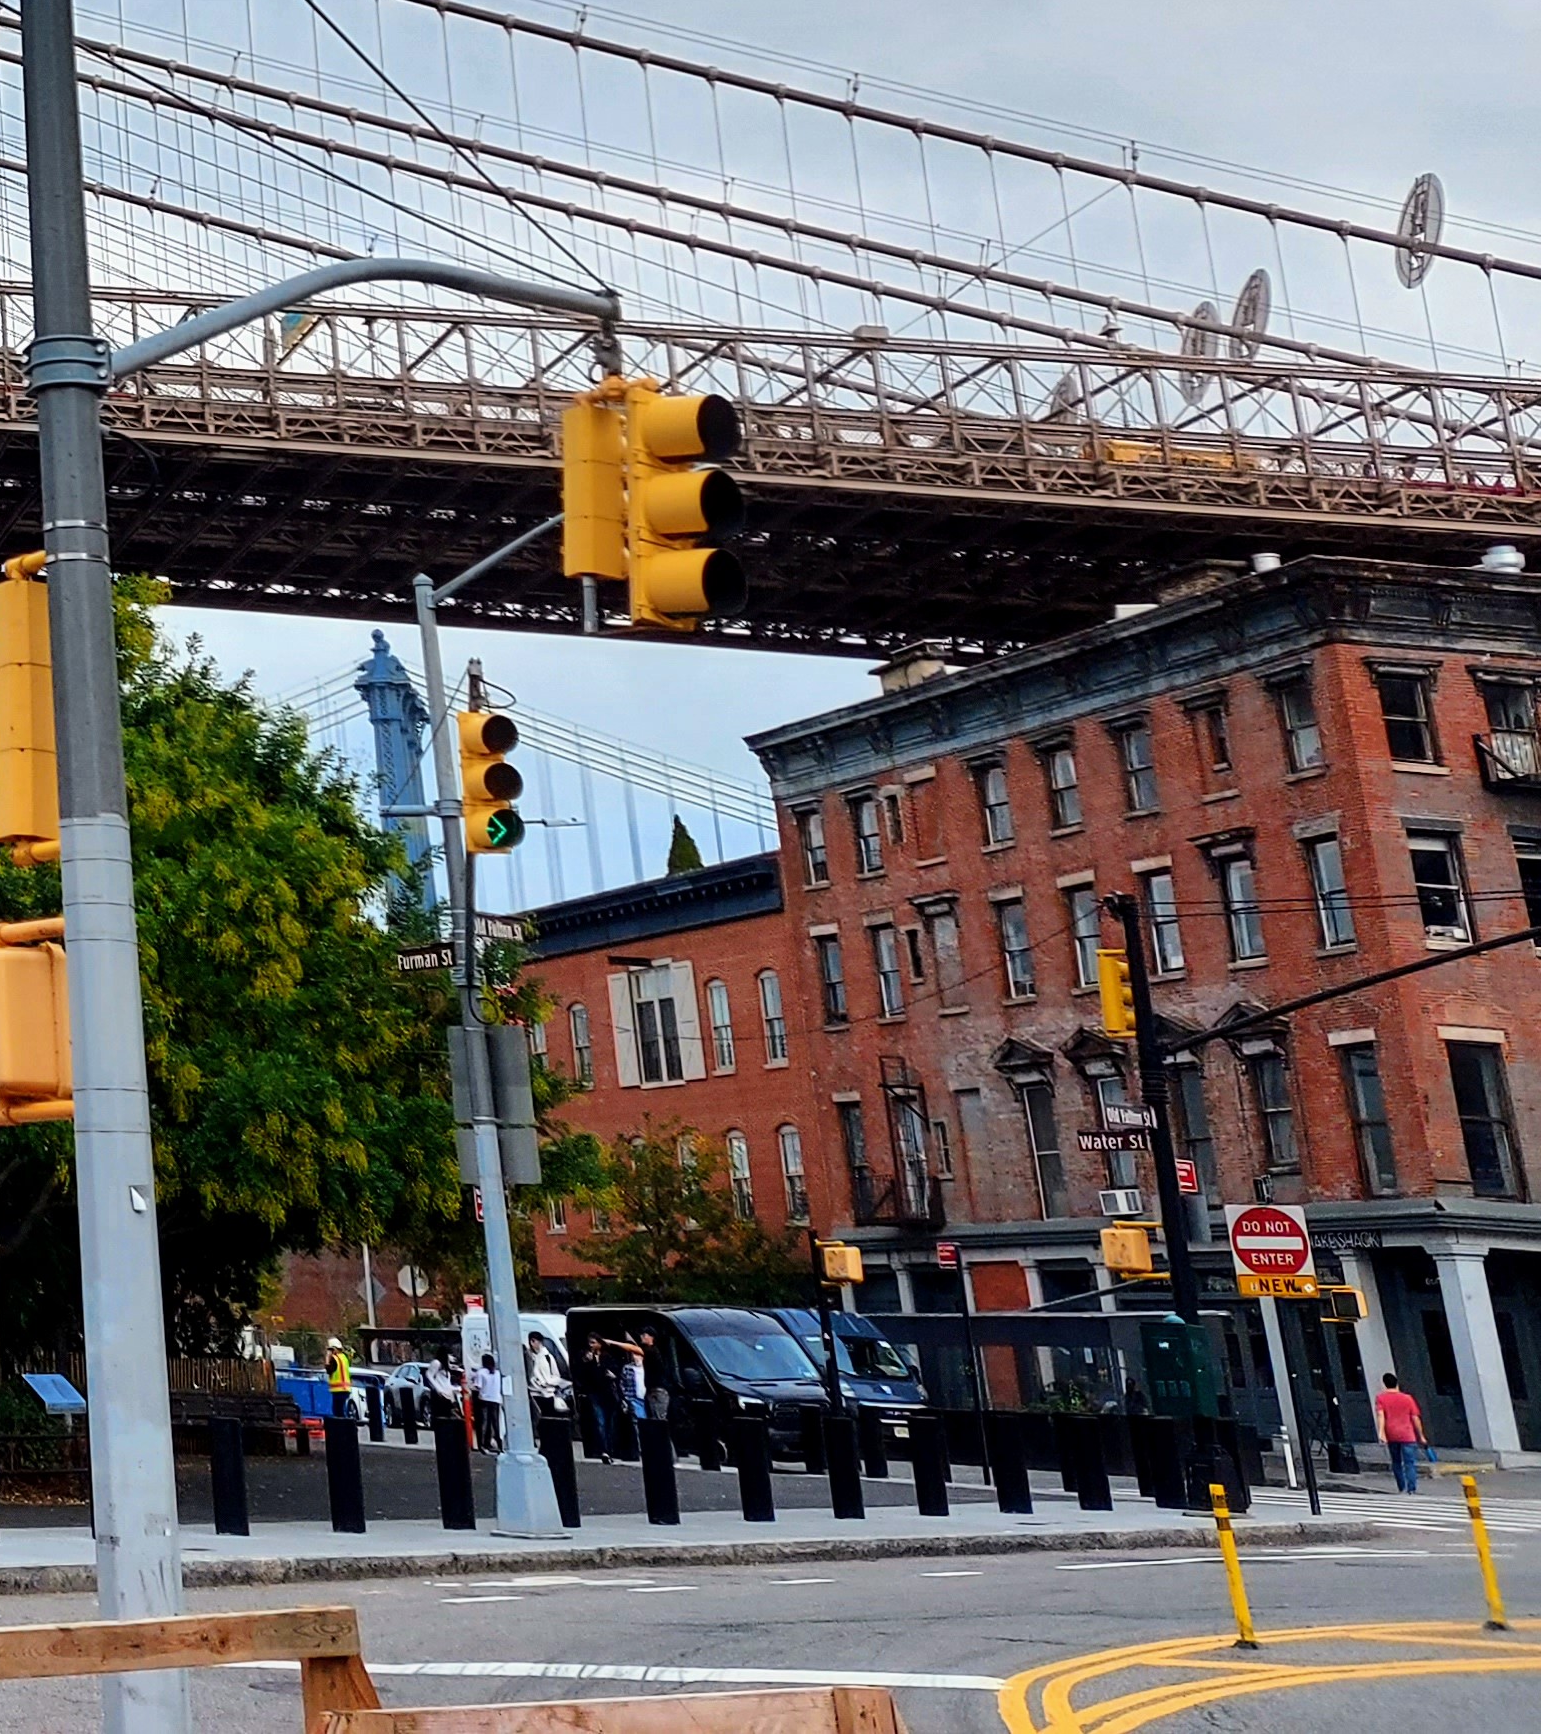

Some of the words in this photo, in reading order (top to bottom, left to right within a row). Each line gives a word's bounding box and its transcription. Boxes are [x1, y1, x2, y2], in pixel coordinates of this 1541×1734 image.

[397, 953, 439, 971] Furman
[440, 949, 454, 966] St
[1078, 1134, 1123, 1150] Water
[1129, 1134, 1146, 1149] St
[1242, 1220, 1261, 1233] DO
[1265, 1220, 1291, 1233] NOT
[1251, 1252, 1295, 1266] ENTER
[1259, 1278, 1296, 1293] NEW
